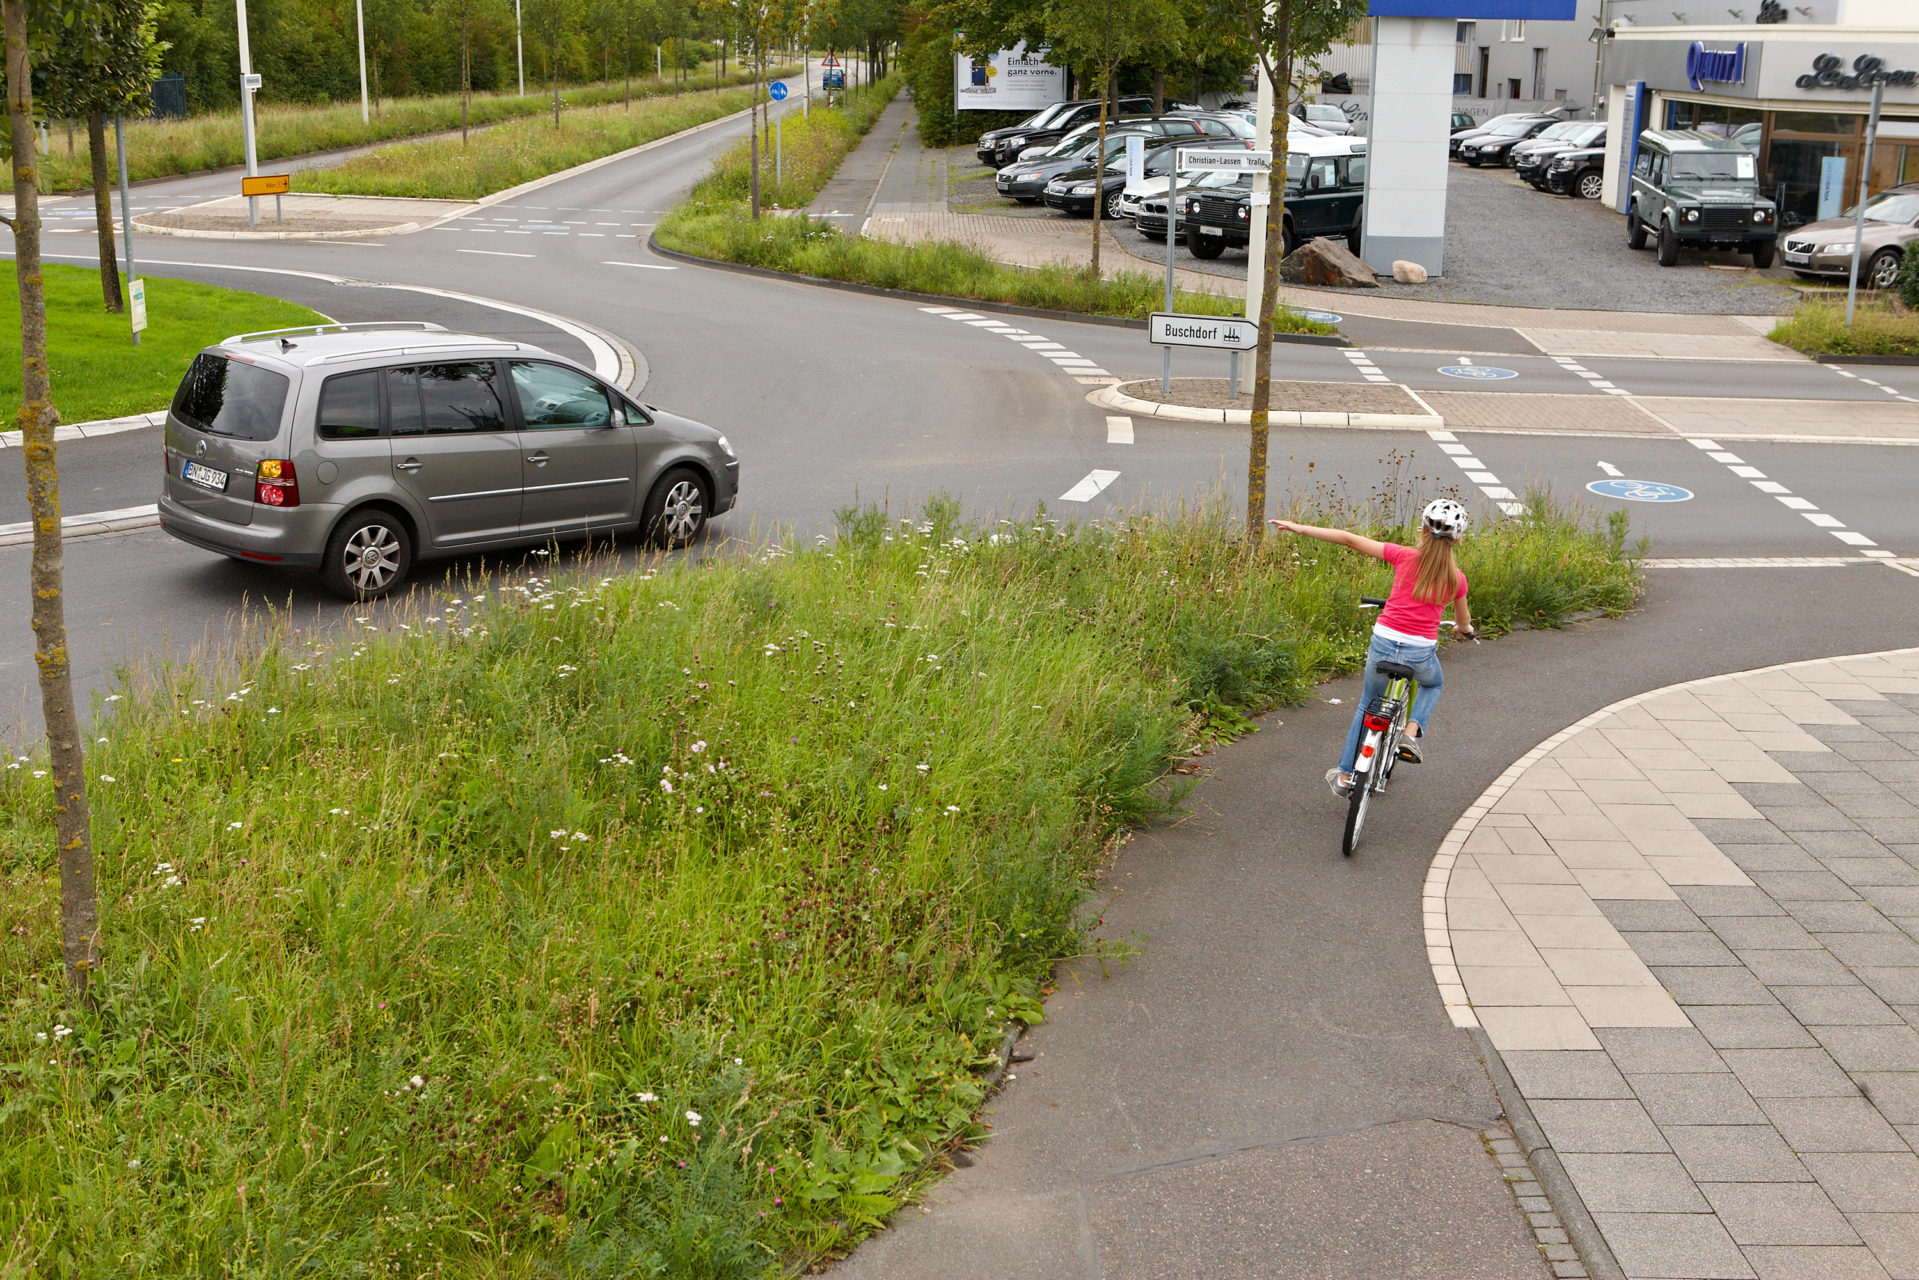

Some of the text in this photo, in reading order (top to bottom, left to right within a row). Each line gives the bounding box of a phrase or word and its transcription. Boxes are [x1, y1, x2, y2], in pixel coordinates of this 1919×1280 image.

[1007, 69, 1028, 77] ganz
[1188, 155, 1266, 166] Christian-Lassentraße
[1165, 323, 1218, 340] Buschdorf
[211, 471, 226, 486] 934
